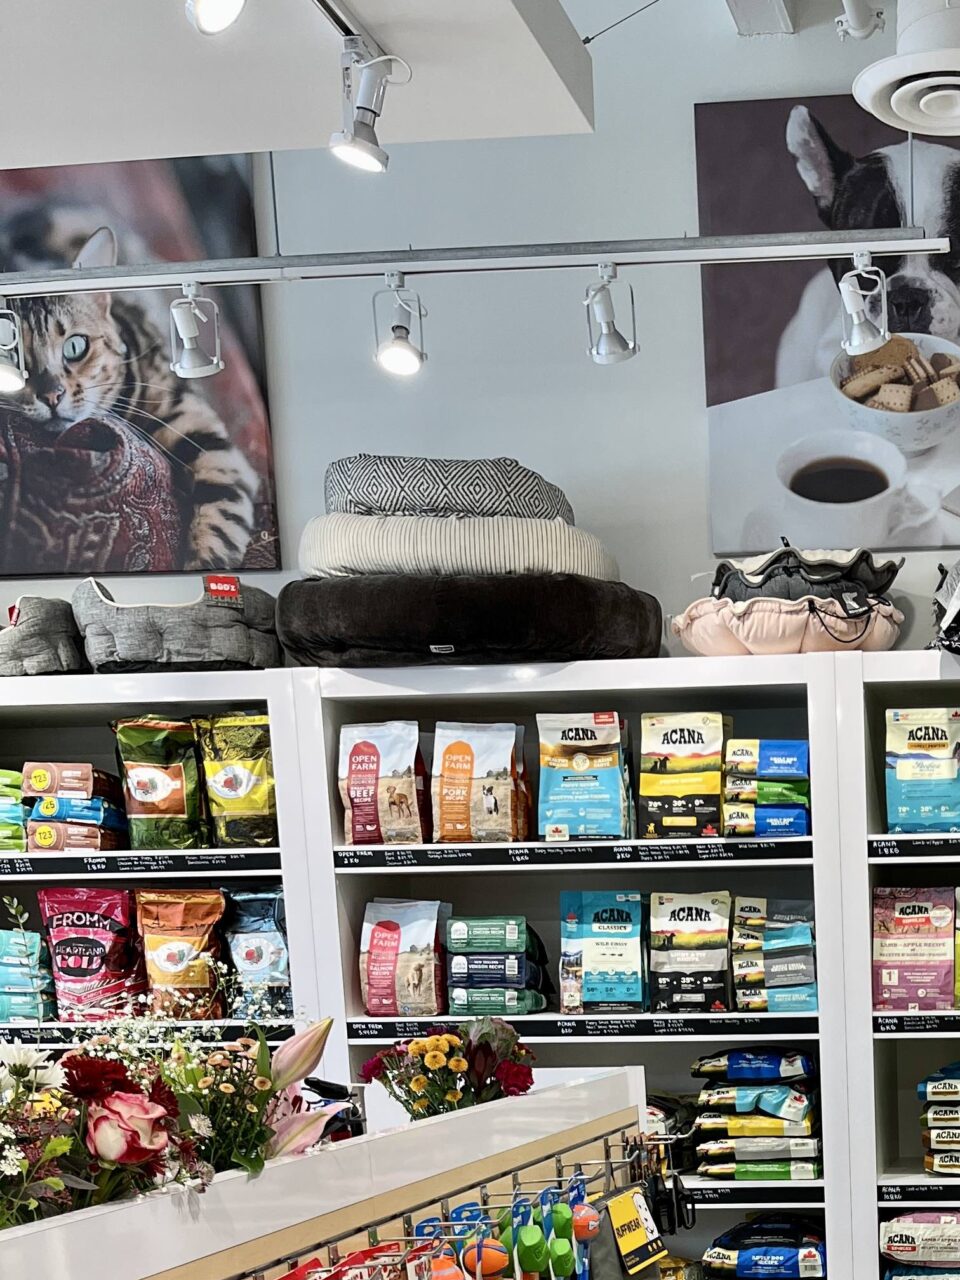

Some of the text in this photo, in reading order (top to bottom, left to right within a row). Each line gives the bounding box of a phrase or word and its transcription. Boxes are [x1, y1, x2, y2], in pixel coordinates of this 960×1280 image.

[561, 728, 597, 741] ACANA
[662, 728, 705, 745] ACANA
[908, 726, 948, 741] ACANA
[731, 749, 753, 757] ACANA
[352, 755, 377, 763] OPEN
[445, 754, 471, 762] OPEN
[352, 763, 377, 771] FARM
[445, 762, 471, 770] FARM
[731, 778, 752, 786] ACANA
[350, 790, 375, 798] BEEF
[729, 811, 750, 820] ACANA
[873, 841, 897, 849] ACANA
[878, 847, 900, 855] 1.8KG
[669, 907, 711, 921] ACANA
[899, 905, 929, 915] ACANA
[593, 908, 633, 922] ACANA
[52, 911, 112, 930] FROMM
[375, 932, 399, 940] OPEN
[373, 939, 398, 947] FARM
[54, 945, 105, 956] HEARTLAND
[56, 954, 101, 969] GOLD
[738, 960, 758, 968] ACANA
[932, 1082, 958, 1090] ACANA
[610, 1217, 641, 1239] RUFFWEAR
[887, 1233, 916, 1244] ACANA
[707, 1250, 731, 1260] ACANA
